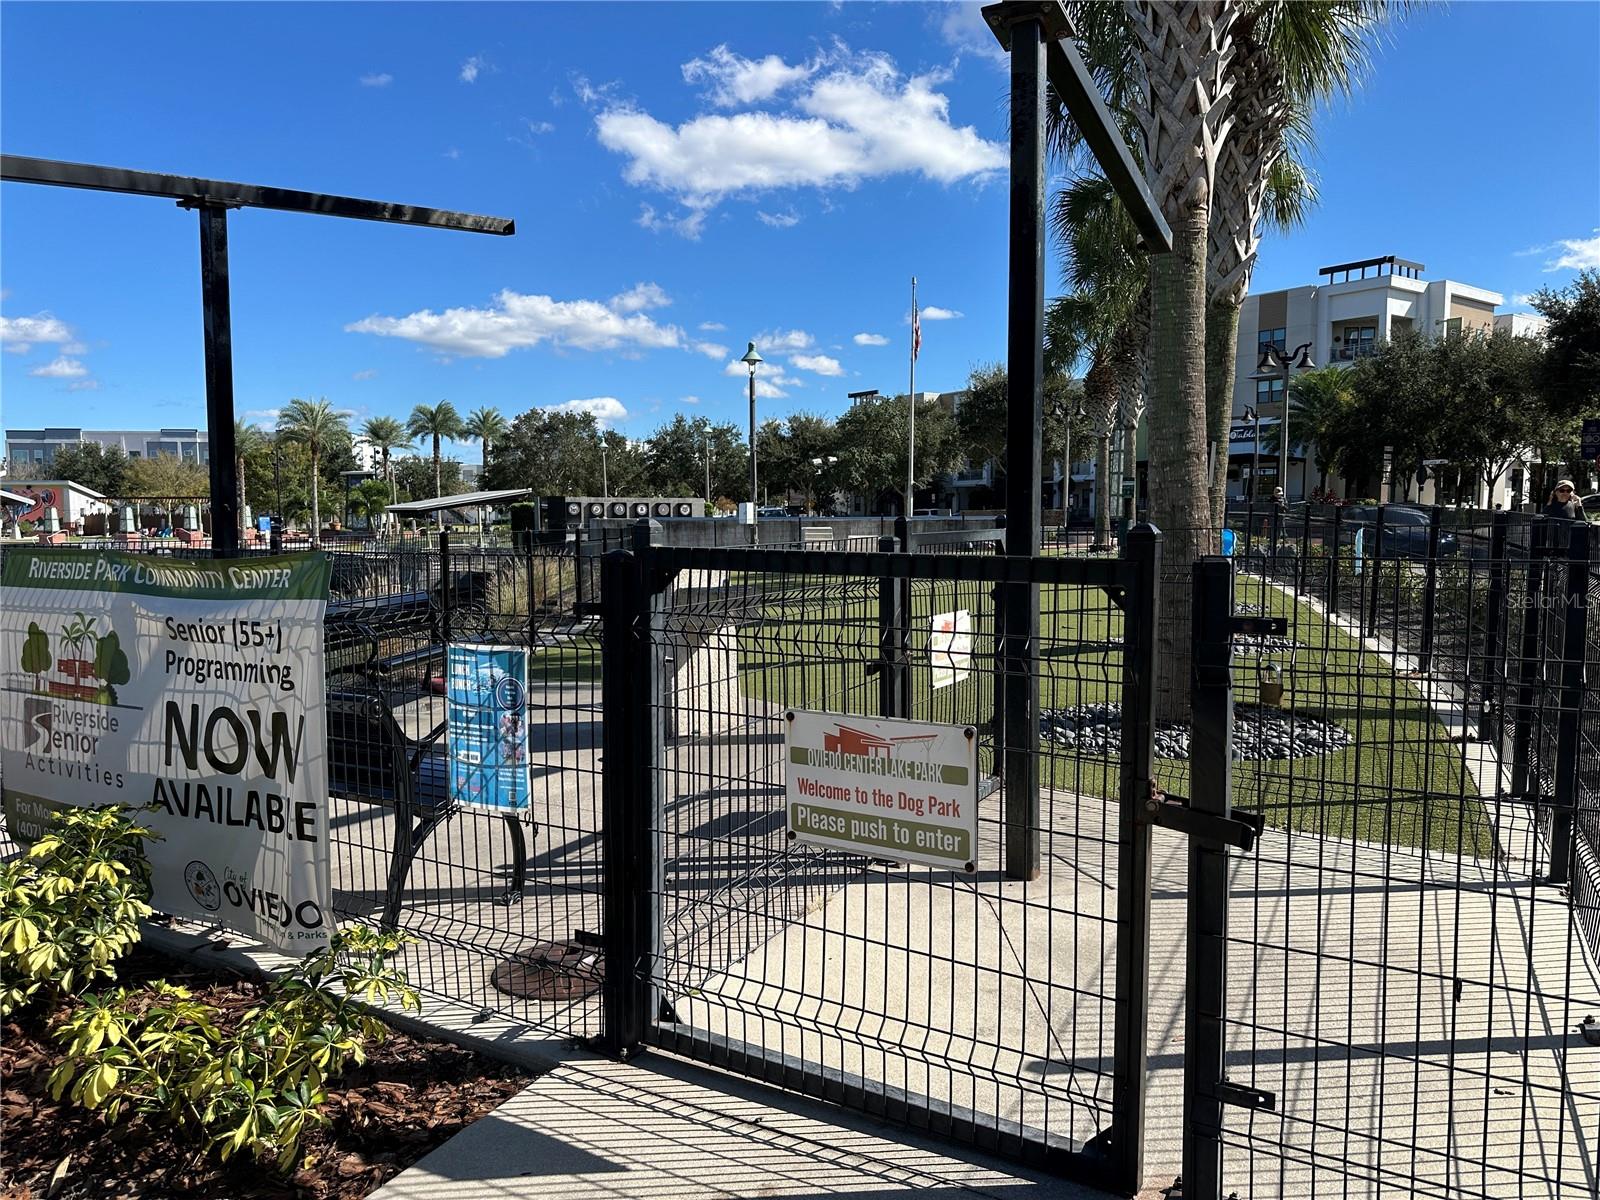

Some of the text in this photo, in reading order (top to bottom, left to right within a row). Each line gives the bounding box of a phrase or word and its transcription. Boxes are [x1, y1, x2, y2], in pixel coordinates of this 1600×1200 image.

[165, 616, 282, 654] Senior (55+)
[166, 650, 295, 691] Programming
[53, 703, 119, 732] Riverside
[165, 700, 304, 785] NOW
[25, 751, 124, 789] Activities
[807, 748, 944, 784] OVIEDO CENTER LAKE PARK
[16, 798, 31, 815] For
[152, 777, 318, 843] AVAILABLE
[797, 777, 961, 818] Welcome to the Dog Park
[16, 819, 42, 838] (407)
[797, 806, 962, 852] Please push to enter
[224, 866, 237, 881] City
[223, 880, 323, 929] OVIEDO
[297, 930, 327, 940] Parks
